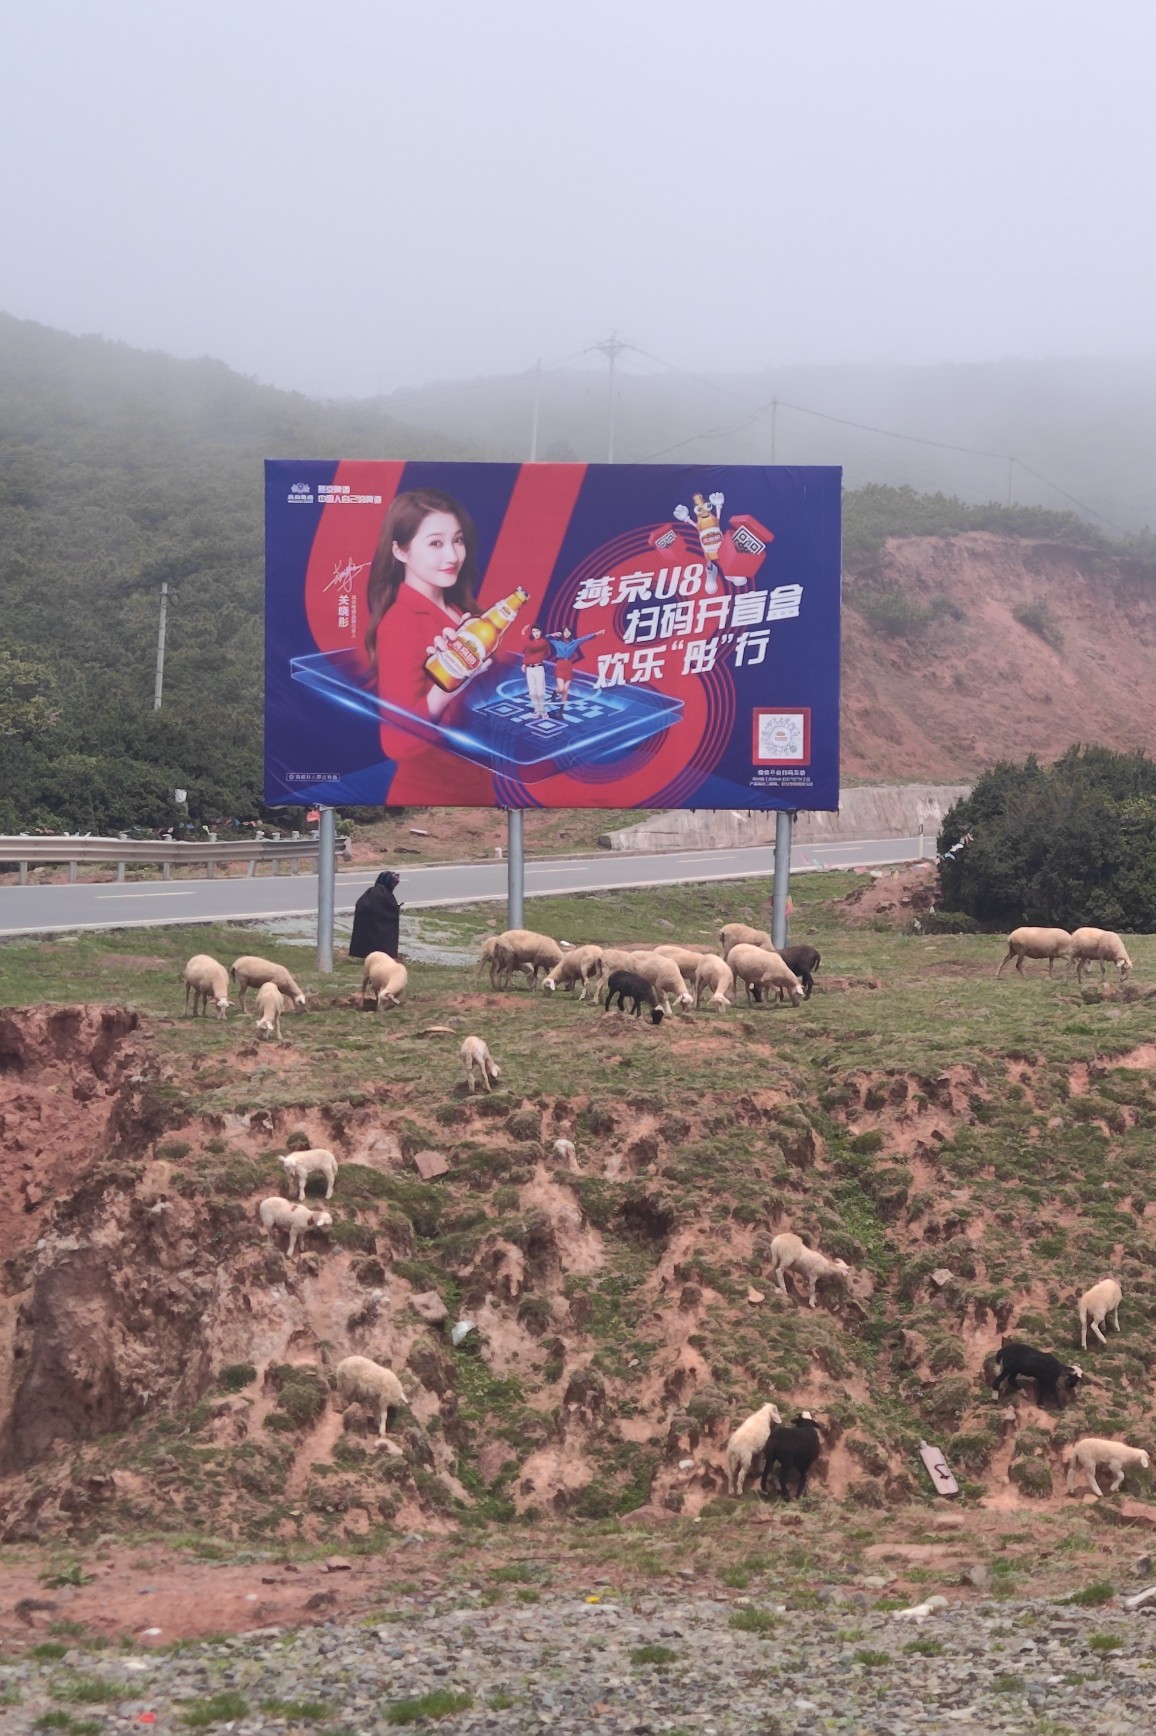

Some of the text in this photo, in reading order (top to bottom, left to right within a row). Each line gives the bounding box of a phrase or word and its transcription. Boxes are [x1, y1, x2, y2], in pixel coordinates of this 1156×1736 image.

[573, 563, 704, 610] 燕京U8
[338, 594, 350, 628] 关晓彤
[623, 584, 803, 644] 扫码开盲盒
